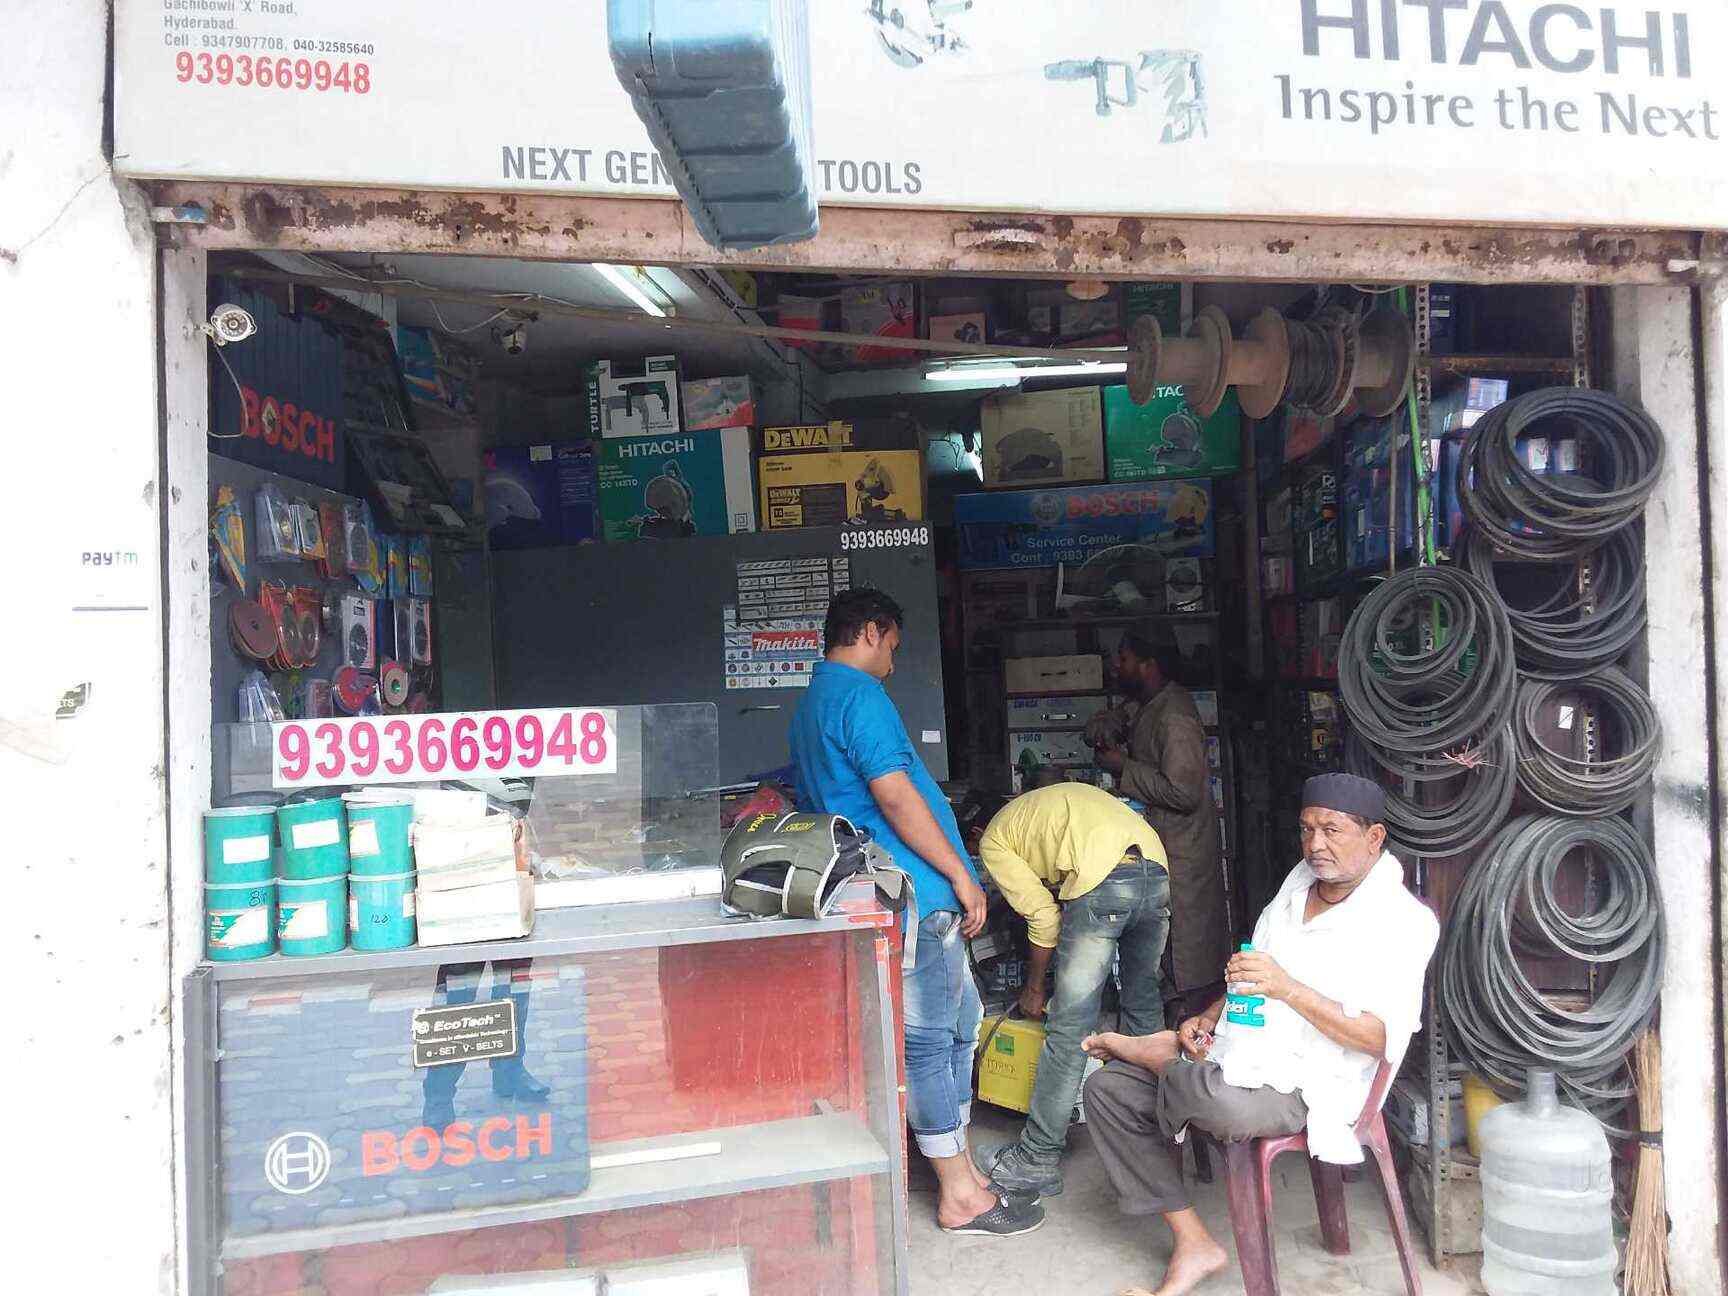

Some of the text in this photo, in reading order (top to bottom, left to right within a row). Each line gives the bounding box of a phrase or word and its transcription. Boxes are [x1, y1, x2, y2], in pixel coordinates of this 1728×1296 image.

[163, 33, 189, 47] Cell
[293, 39, 375, 55] 040-32585640
[1301, 0, 1692, 79] HITACHI
[175, 51, 371, 95] 9393669948
[1274, 74, 1721, 141] Inspire the Next
[502, 145, 593, 182] NEXT
[818, 159, 923, 195] TOOLS
[240, 384, 335, 464] BOSCH
[618, 437, 695, 458] HITACHI
[1066, 489, 1161, 519] BOSCH
[840, 527, 929, 550] 9393669948
[1026, 533, 1122, 549] Service Center
[81, 551, 139, 566] paytm
[278, 711, 608, 781] 9393669948
[433, 1014, 494, 1032] EcoTech
[476, 1040, 504, 1051] BELTS
[361, 1112, 552, 1177] BOSCH
